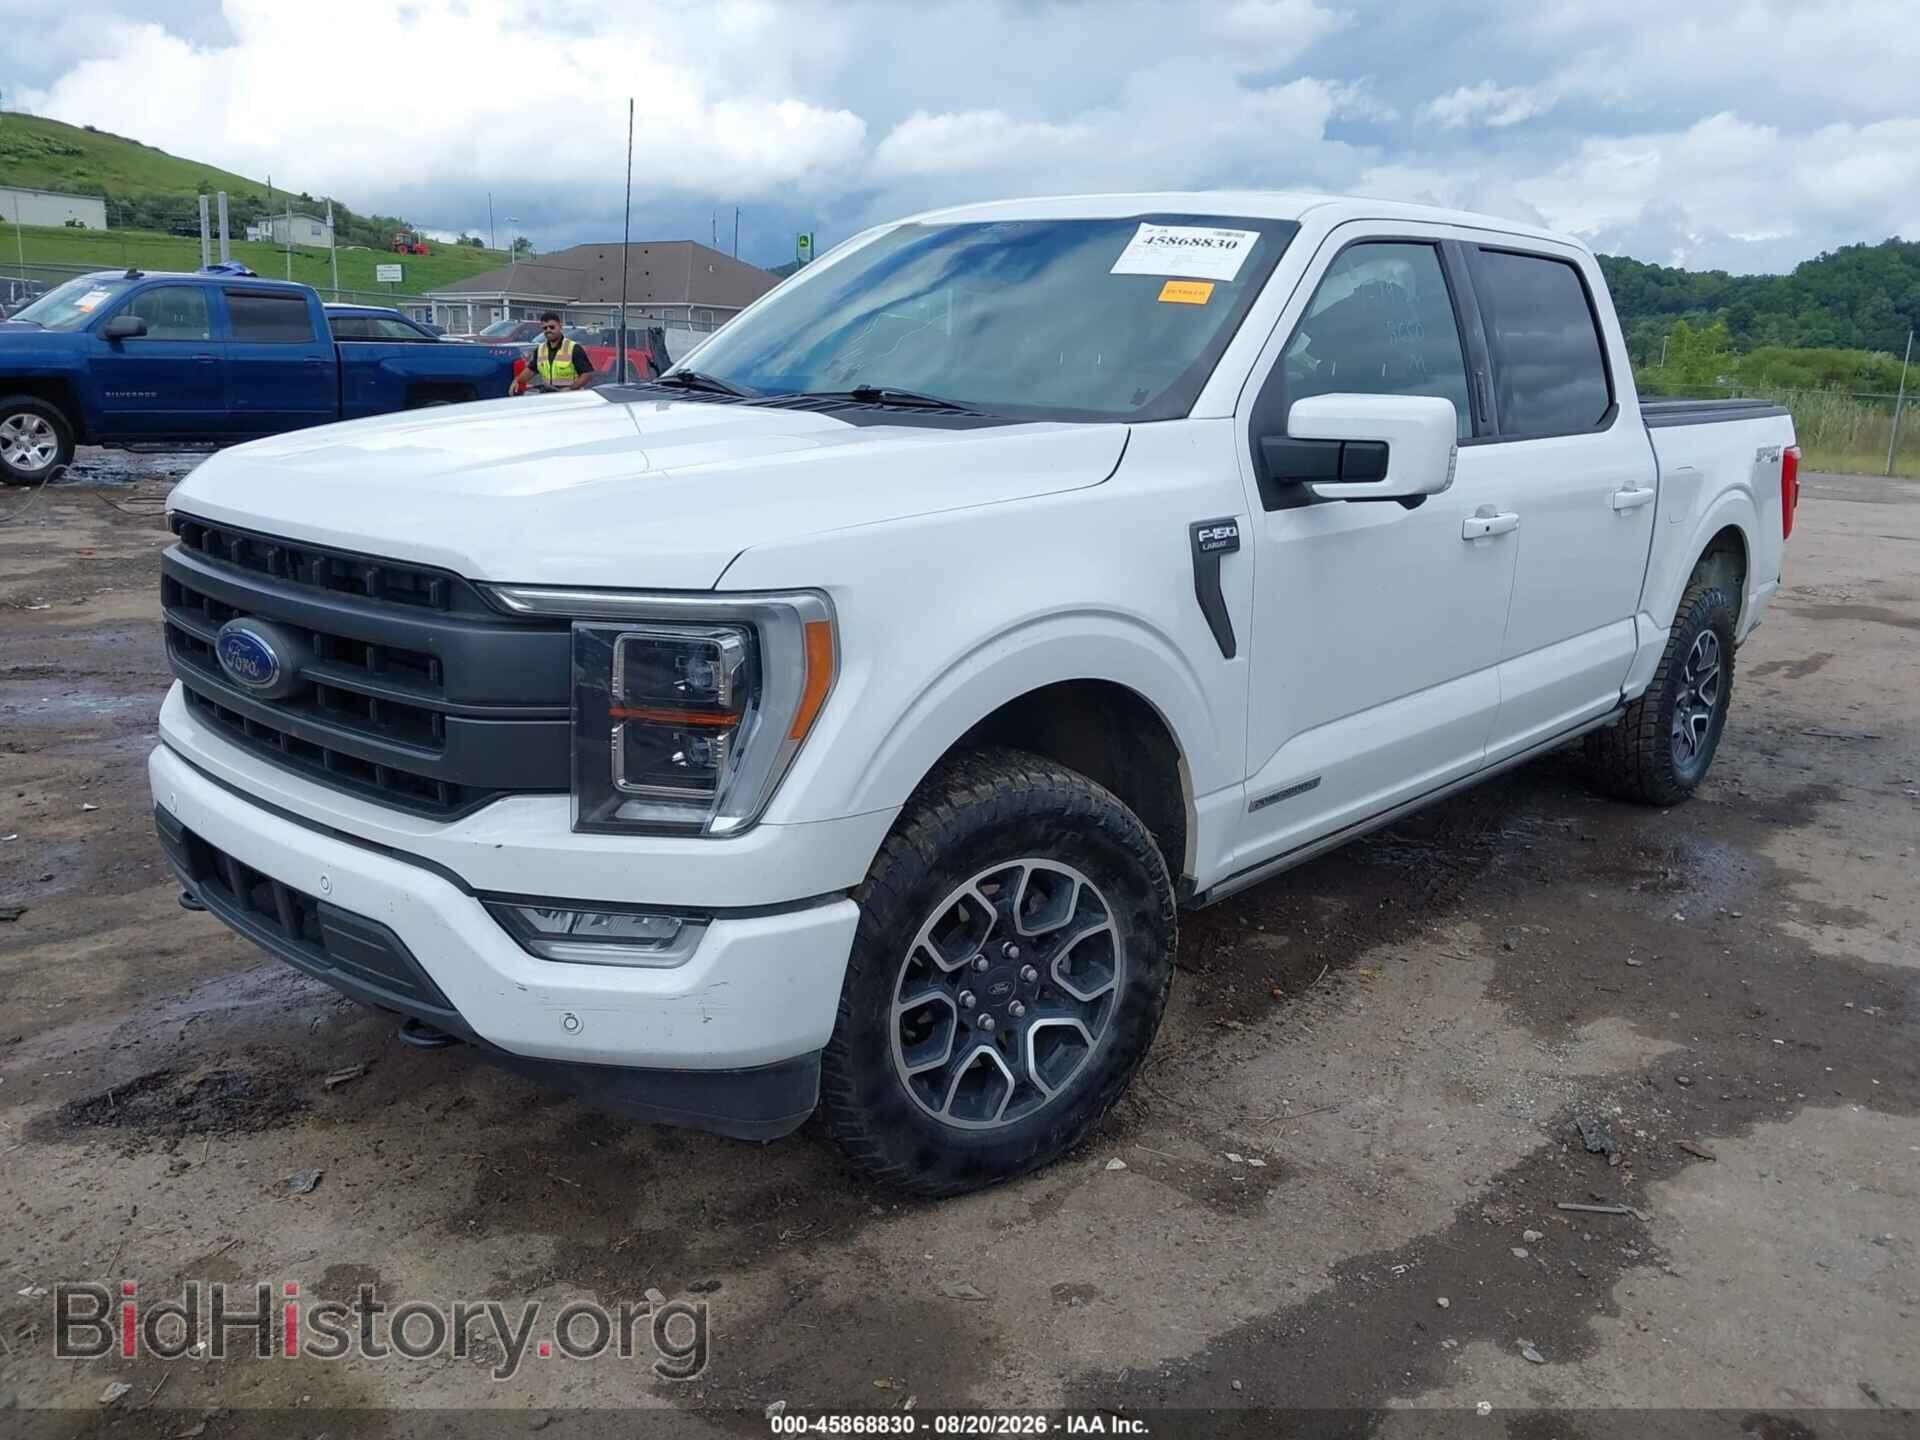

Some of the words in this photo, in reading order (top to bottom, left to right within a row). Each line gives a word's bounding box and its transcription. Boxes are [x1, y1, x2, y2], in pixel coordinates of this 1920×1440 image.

[1143, 235, 1238, 250] 45868830
[1199, 526, 1238, 542] F-150
[225, 639, 266, 677] Ford
